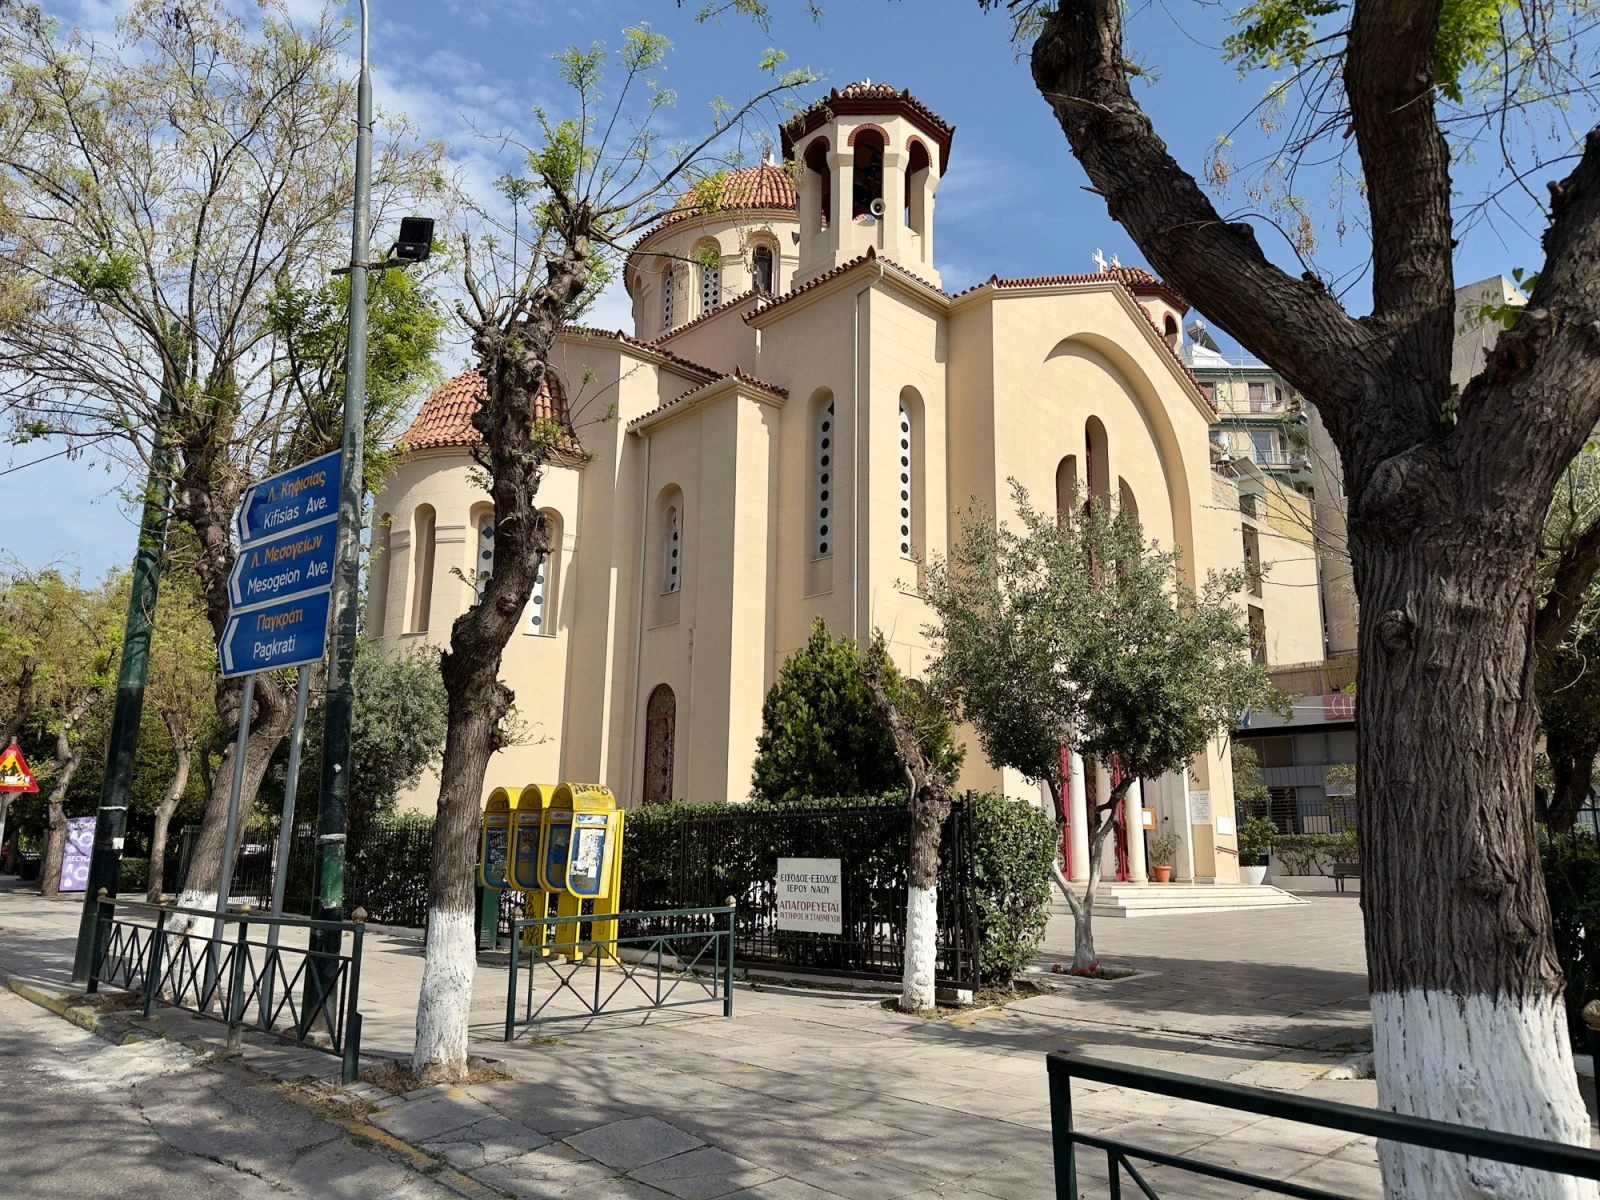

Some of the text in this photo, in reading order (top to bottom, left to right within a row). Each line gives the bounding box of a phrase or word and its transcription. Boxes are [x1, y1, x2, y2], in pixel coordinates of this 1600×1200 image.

[281, 470, 326, 499] Κηφισίας
[263, 496, 328, 529] Kifisias Ave.
[264, 535, 323, 565] Μεσογείων
[247, 560, 329, 595] Mesogeion Ave.
[256, 606, 304, 632] Παγκράτι
[252, 634, 297, 661] Pagkrati
[786, 884, 830, 894] ΙΕΡΟΥ ΝΑΟΥ
[779, 900, 839, 912] ΑΠΑΓΟΡΕΥΕΤΑΙ
